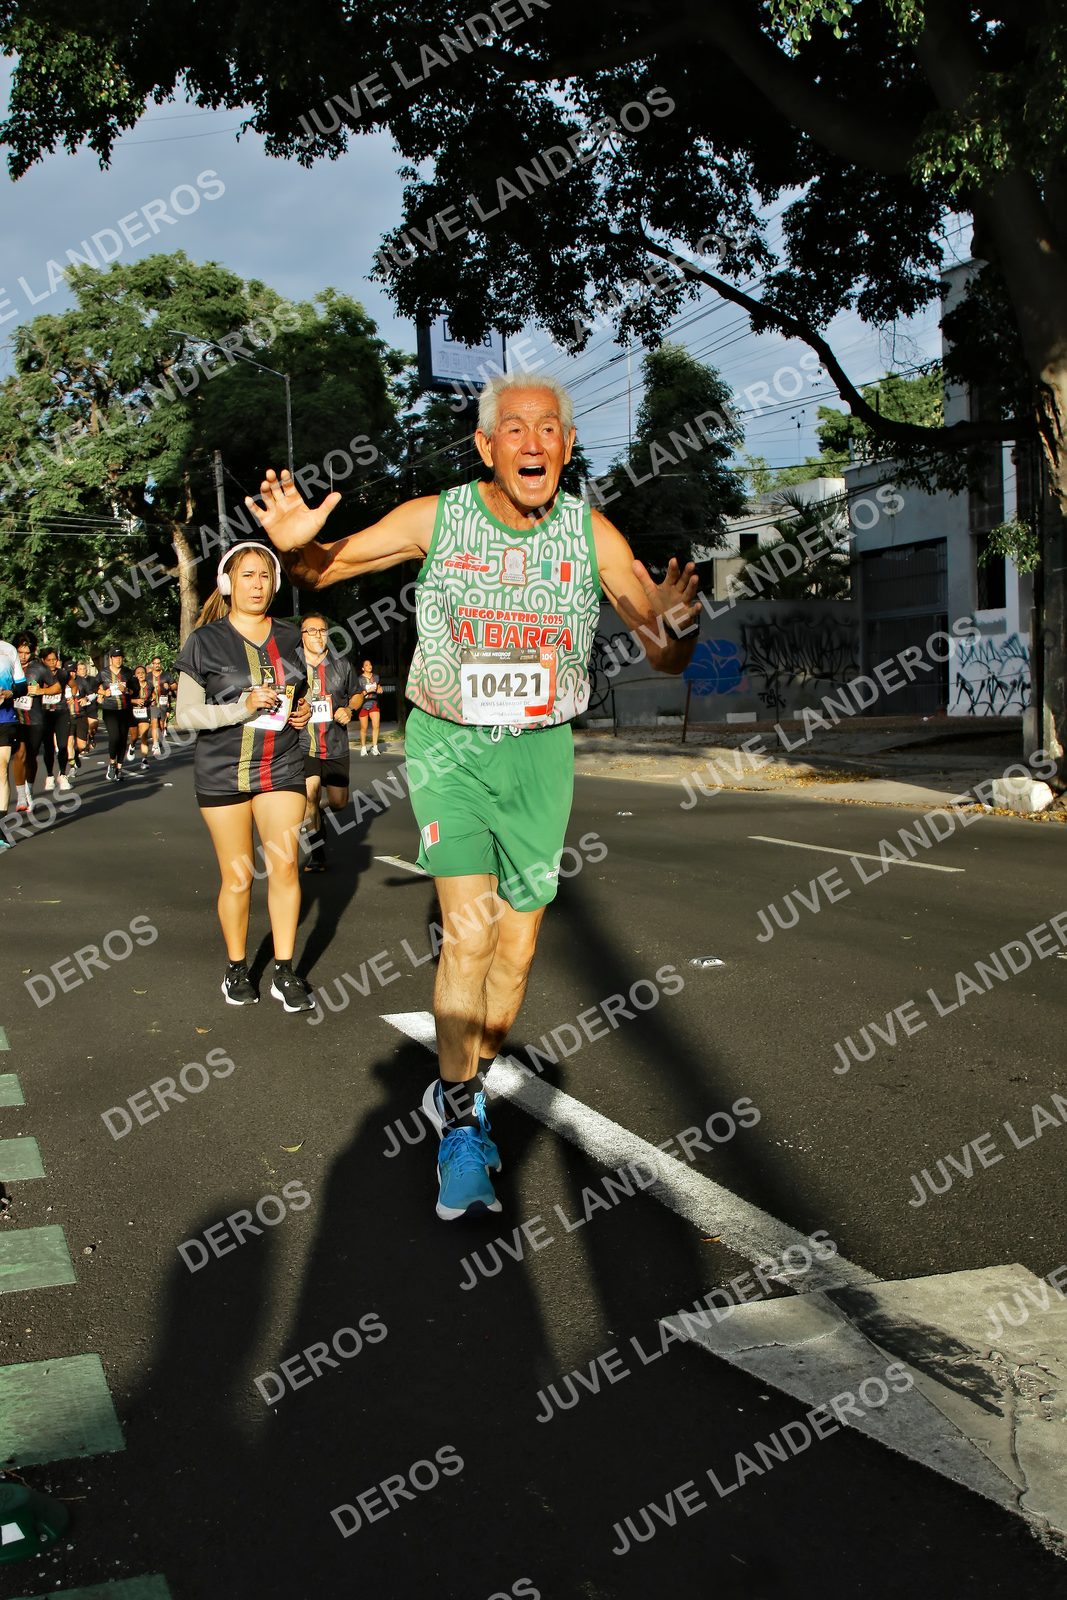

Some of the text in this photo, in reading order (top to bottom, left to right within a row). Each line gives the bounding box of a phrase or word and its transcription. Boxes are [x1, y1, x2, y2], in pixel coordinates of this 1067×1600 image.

[444, 559, 490, 573] GERSO
[458, 606, 563, 625] FUEGO PATRIO 2025
[450, 616, 573, 651] LA BARCA
[466, 672, 541, 698] 10421
